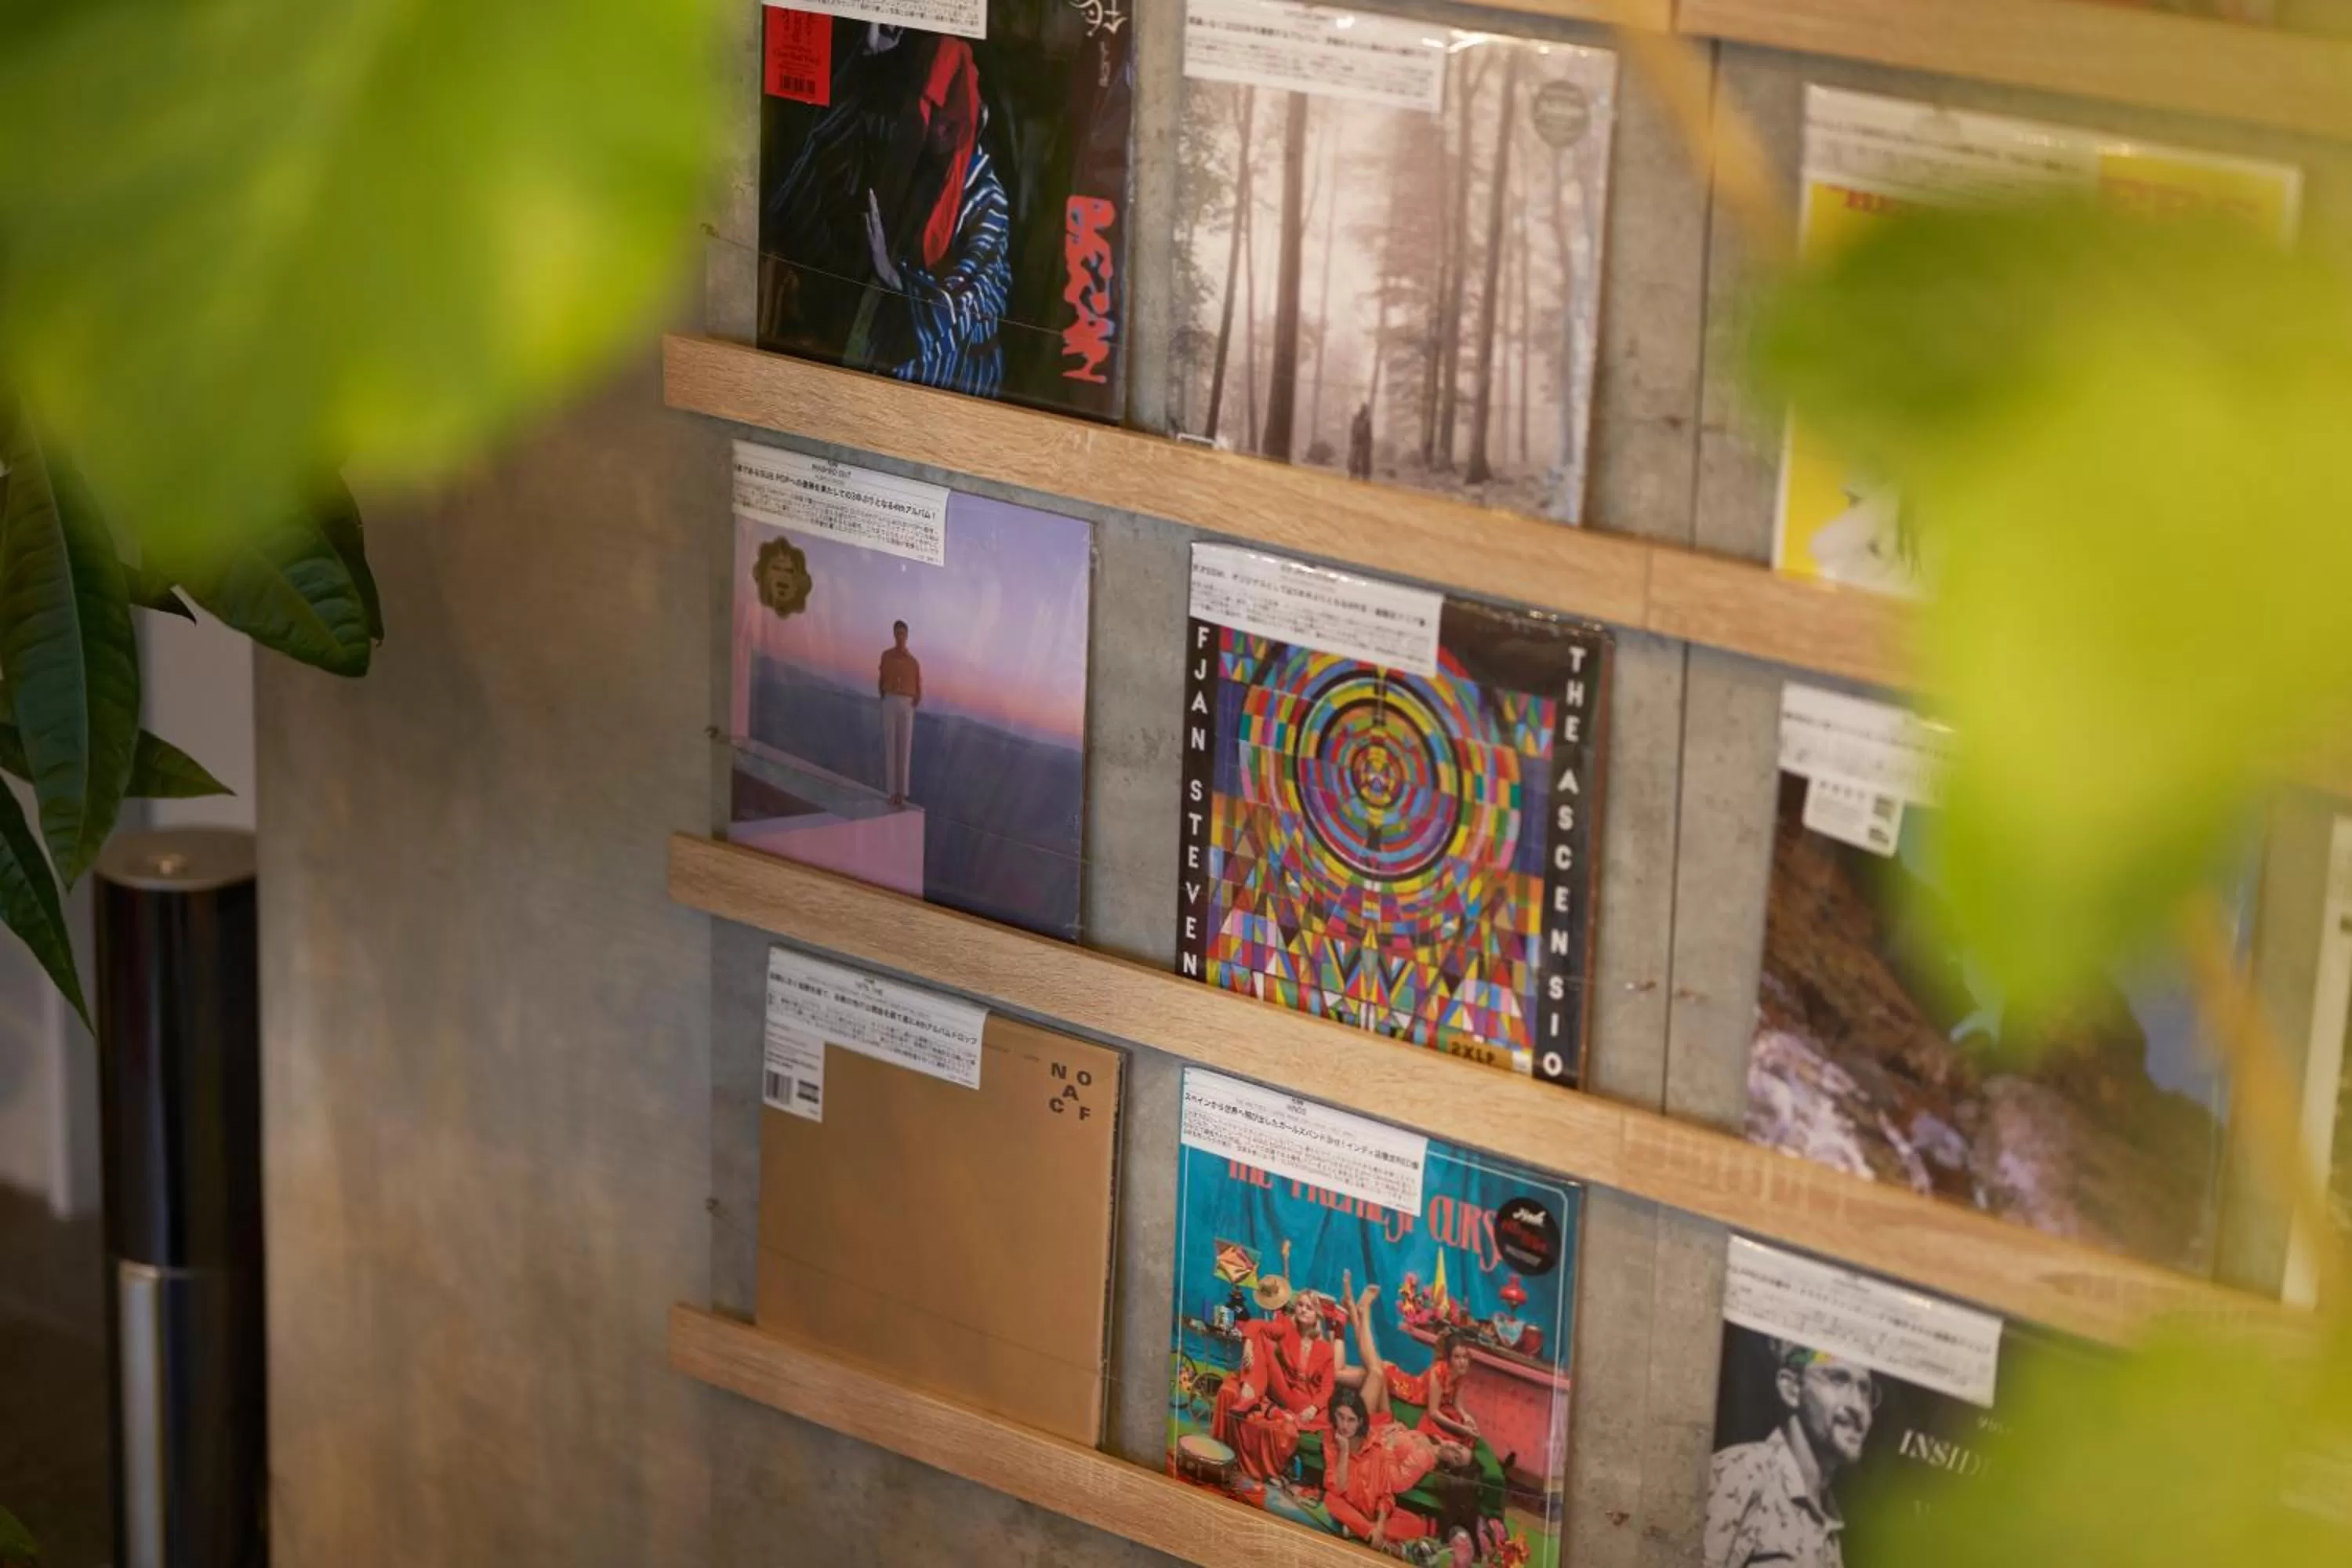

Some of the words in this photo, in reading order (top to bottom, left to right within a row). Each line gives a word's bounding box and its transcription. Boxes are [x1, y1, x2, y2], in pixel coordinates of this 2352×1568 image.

[1191, 626, 1210, 751] FJAN
[1564, 647, 1586, 742] THE
[1182, 779, 1203, 978] STEVEN
[1543, 768, 1581, 1076] ASCENSIO
[1428, 1195, 1503, 1272] CURS
